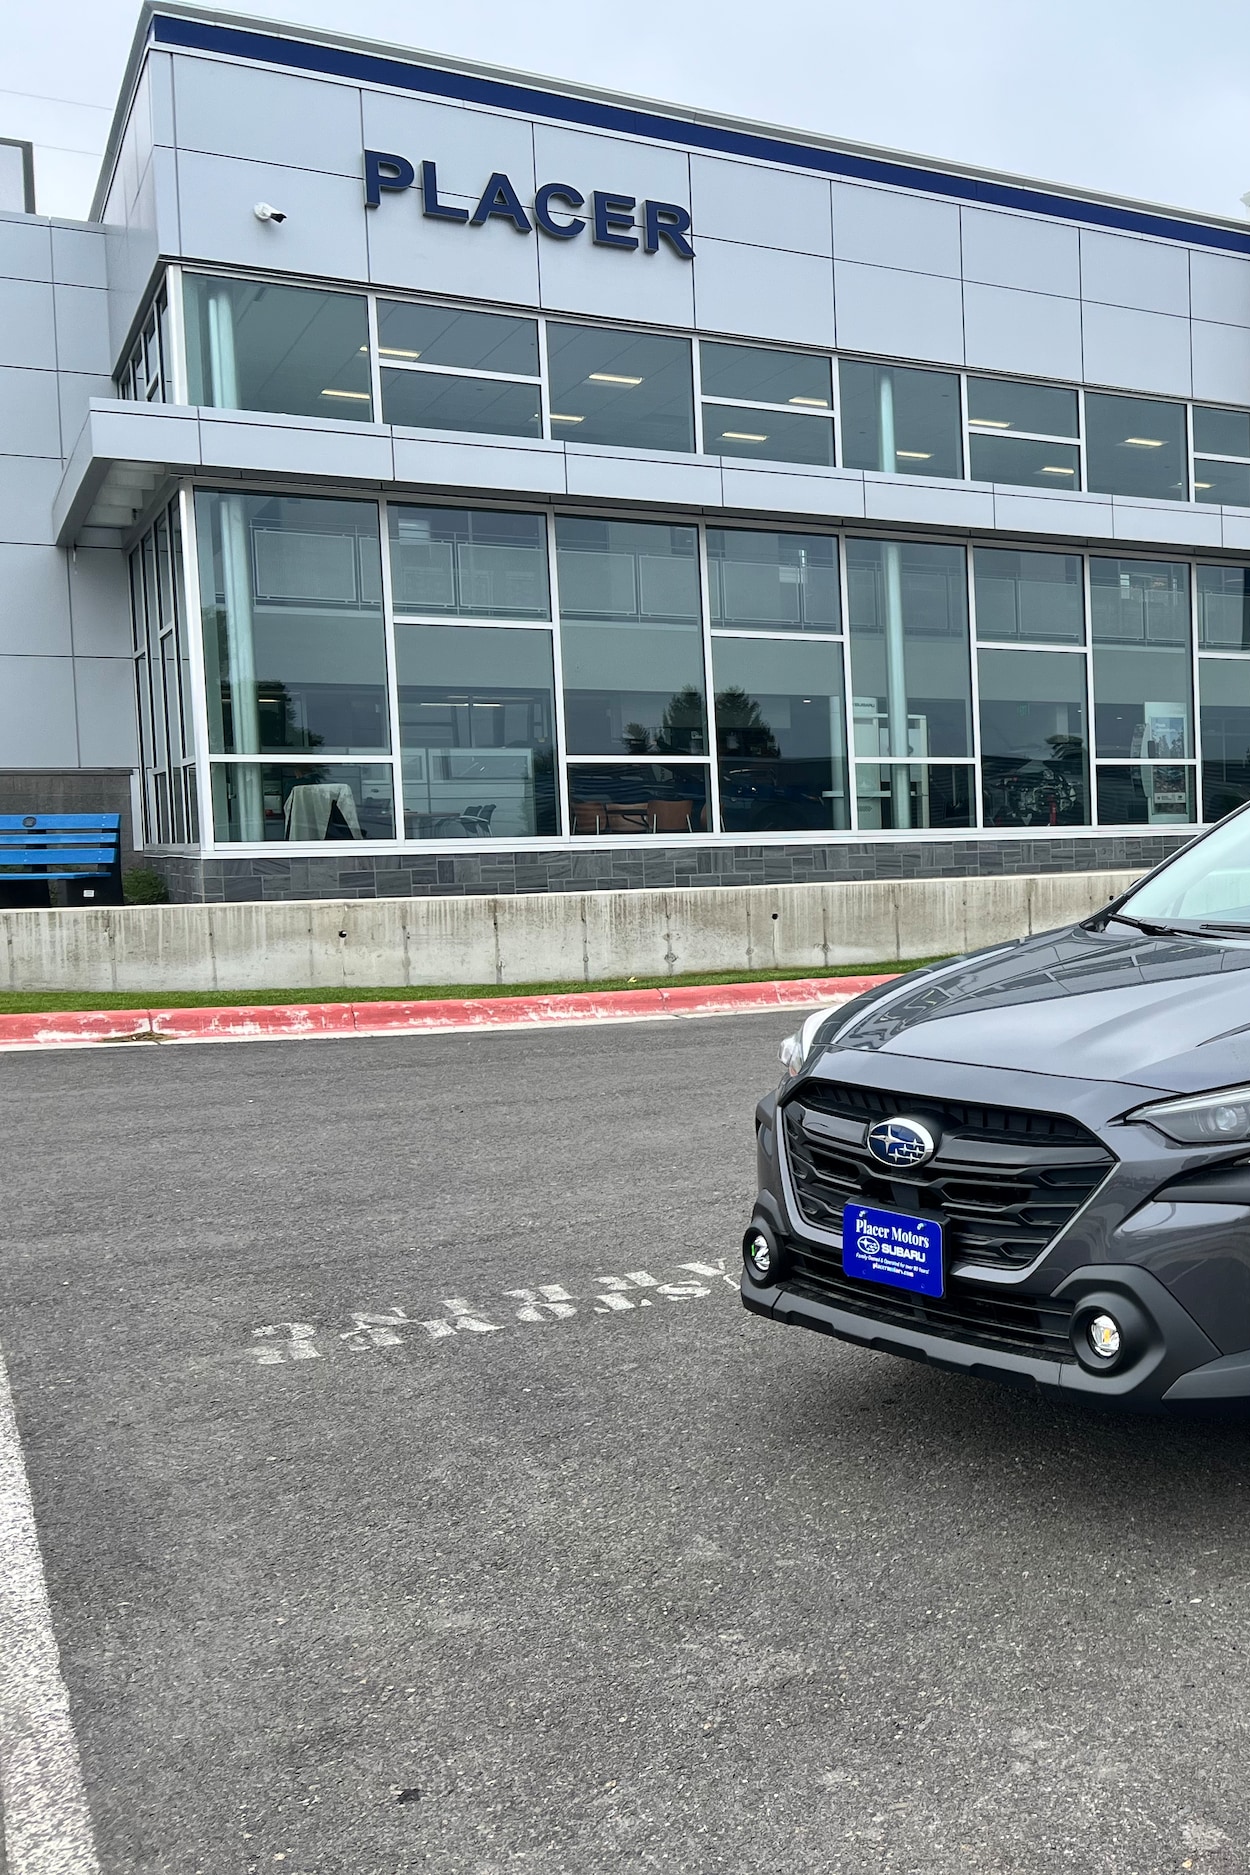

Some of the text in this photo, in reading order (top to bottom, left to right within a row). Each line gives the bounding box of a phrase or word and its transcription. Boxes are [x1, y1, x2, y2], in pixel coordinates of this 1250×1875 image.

[364, 149, 696, 260] PLACER
[855, 1219, 930, 1249] Placer Motors
[881, 1243, 926, 1263] SUBARU
[245, 1272, 741, 1366] STOMER
[250, 1257, 727, 1343] ARKING
